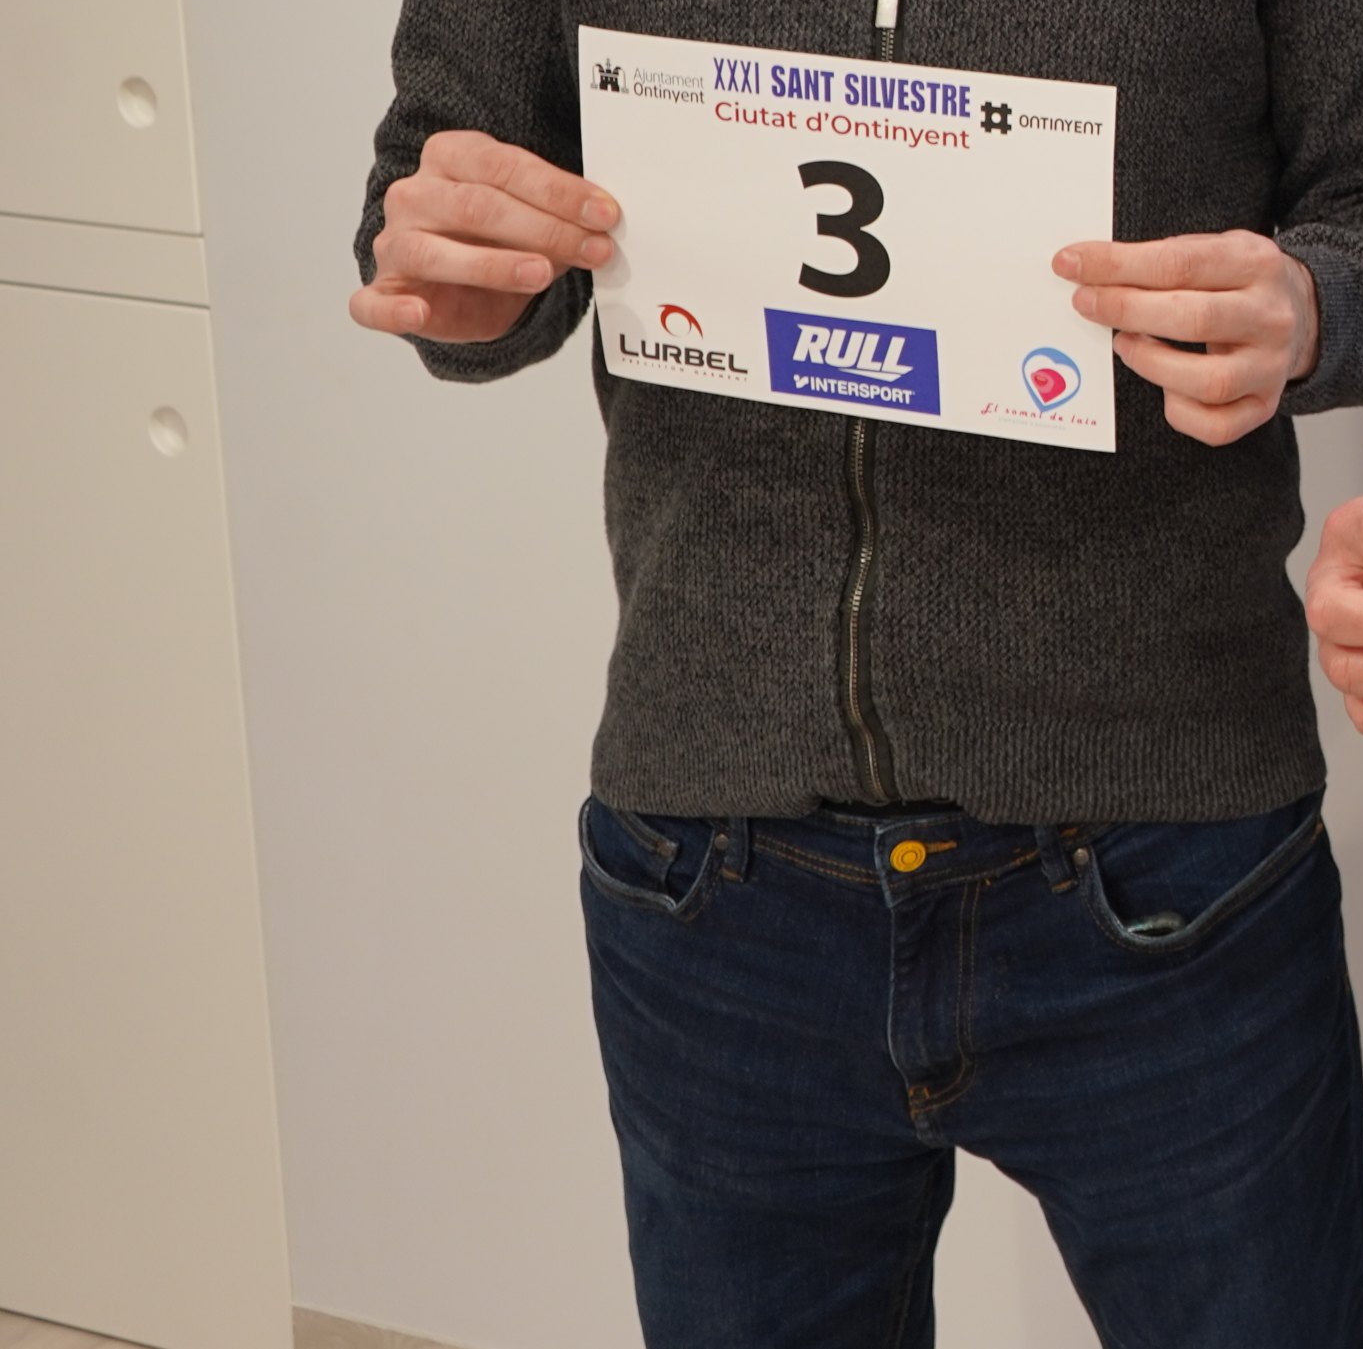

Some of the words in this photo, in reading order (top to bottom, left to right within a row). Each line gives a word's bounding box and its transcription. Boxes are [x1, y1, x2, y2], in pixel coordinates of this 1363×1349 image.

[633, 85, 704, 104] Ontinyent
[634, 67, 704, 89] Ajuntament
[713, 57, 760, 94] XXXI
[771, 65, 835, 102] SANT
[844, 73, 971, 118] SILVESTRE
[715, 102, 797, 130] Ciutat
[805, 111, 971, 149] d'Ontinyent
[1018, 114, 1103, 136] ONTINYENT
[797, 160, 891, 298] 3
[619, 333, 748, 374] LURBEL
[792, 323, 913, 376] RULL
[810, 374, 912, 404] INTERSPORT
